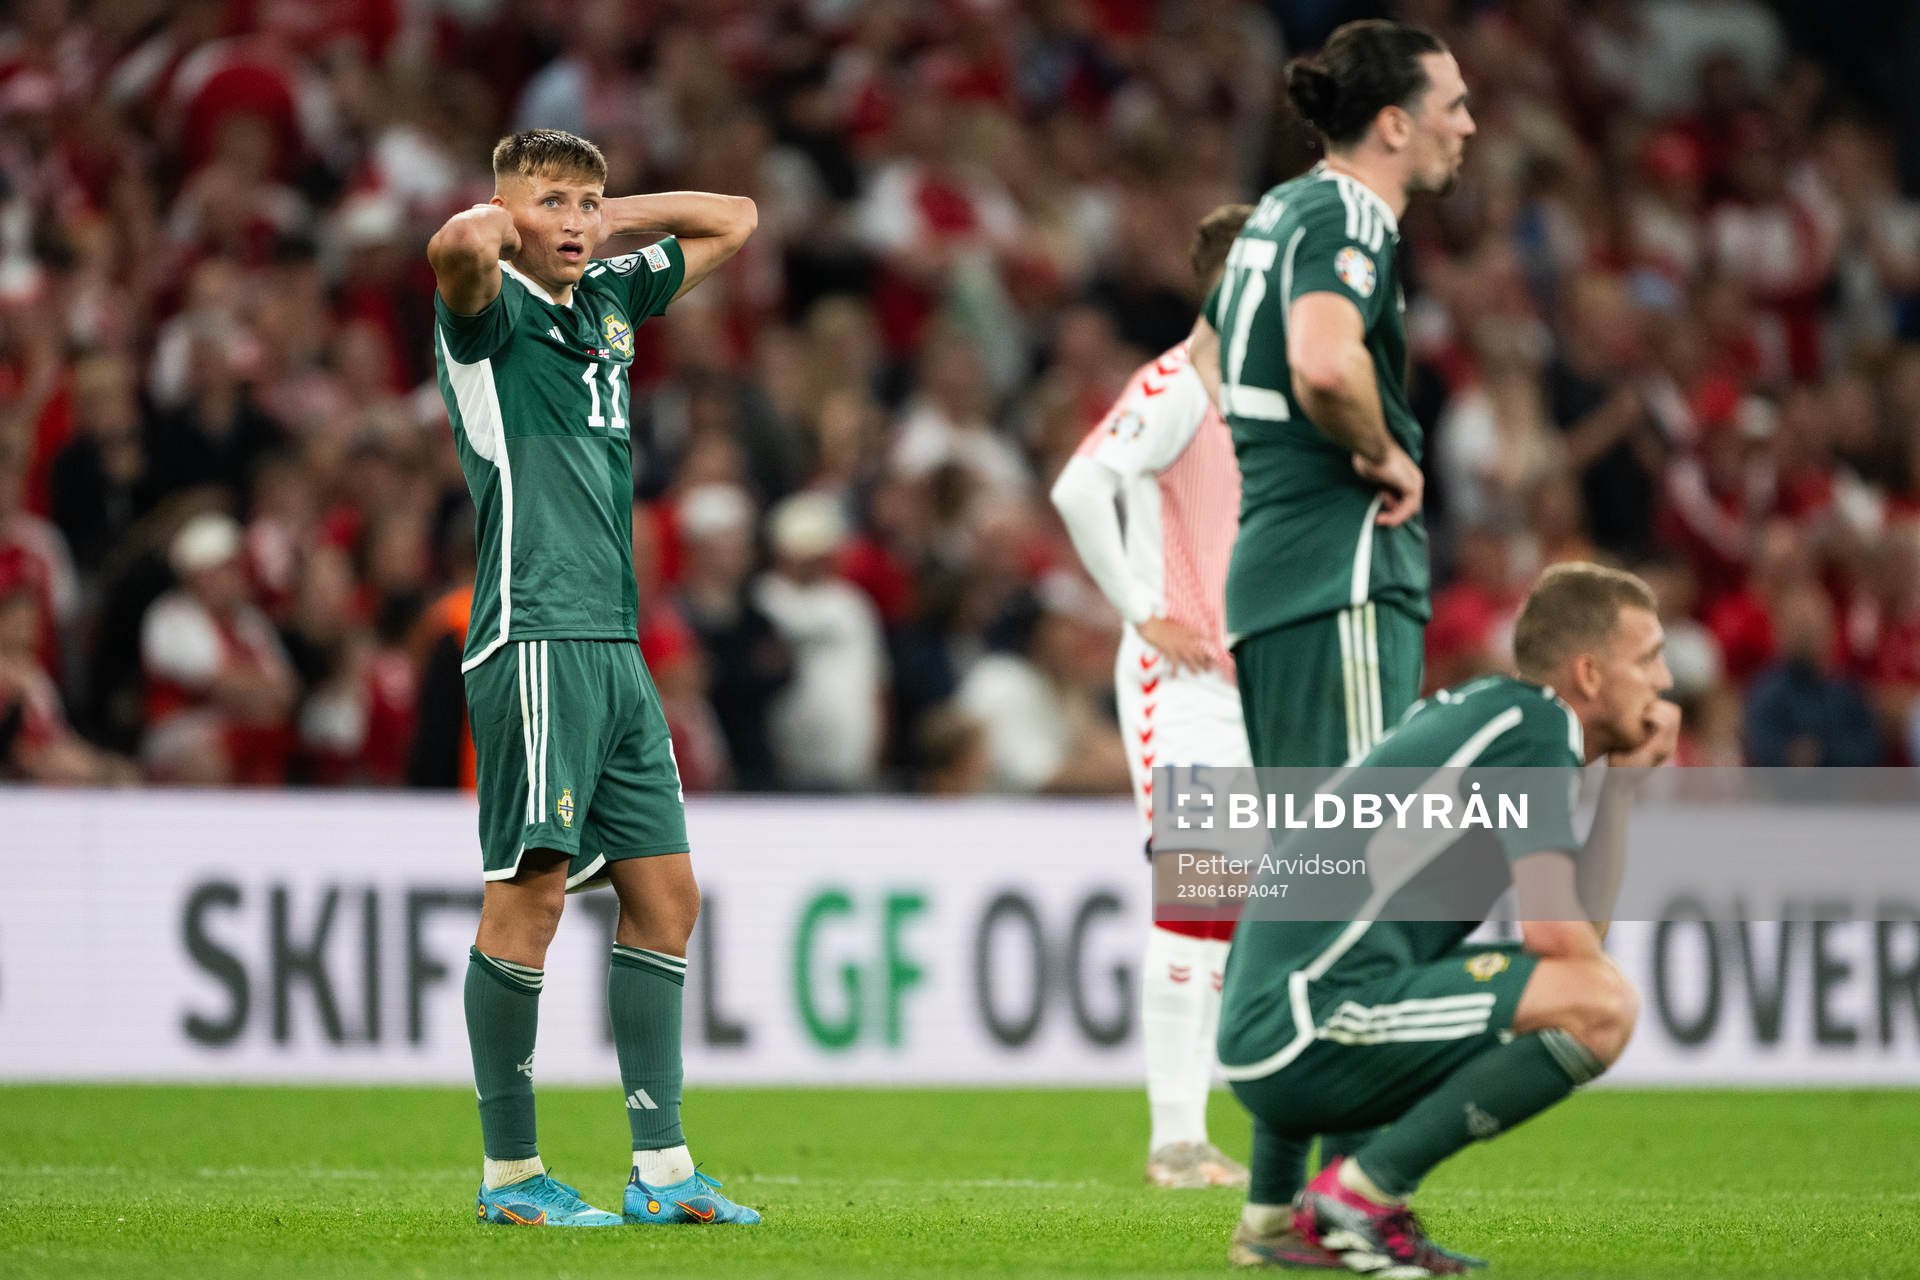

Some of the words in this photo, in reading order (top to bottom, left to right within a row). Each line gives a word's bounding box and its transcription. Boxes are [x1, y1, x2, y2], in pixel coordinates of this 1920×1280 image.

[582, 362, 625, 428] 11
[1164, 764, 1214, 813] 15
[180, 881, 485, 1047] SKIF
[791, 887, 927, 1049] GF
[974, 887, 1133, 1049] OG
